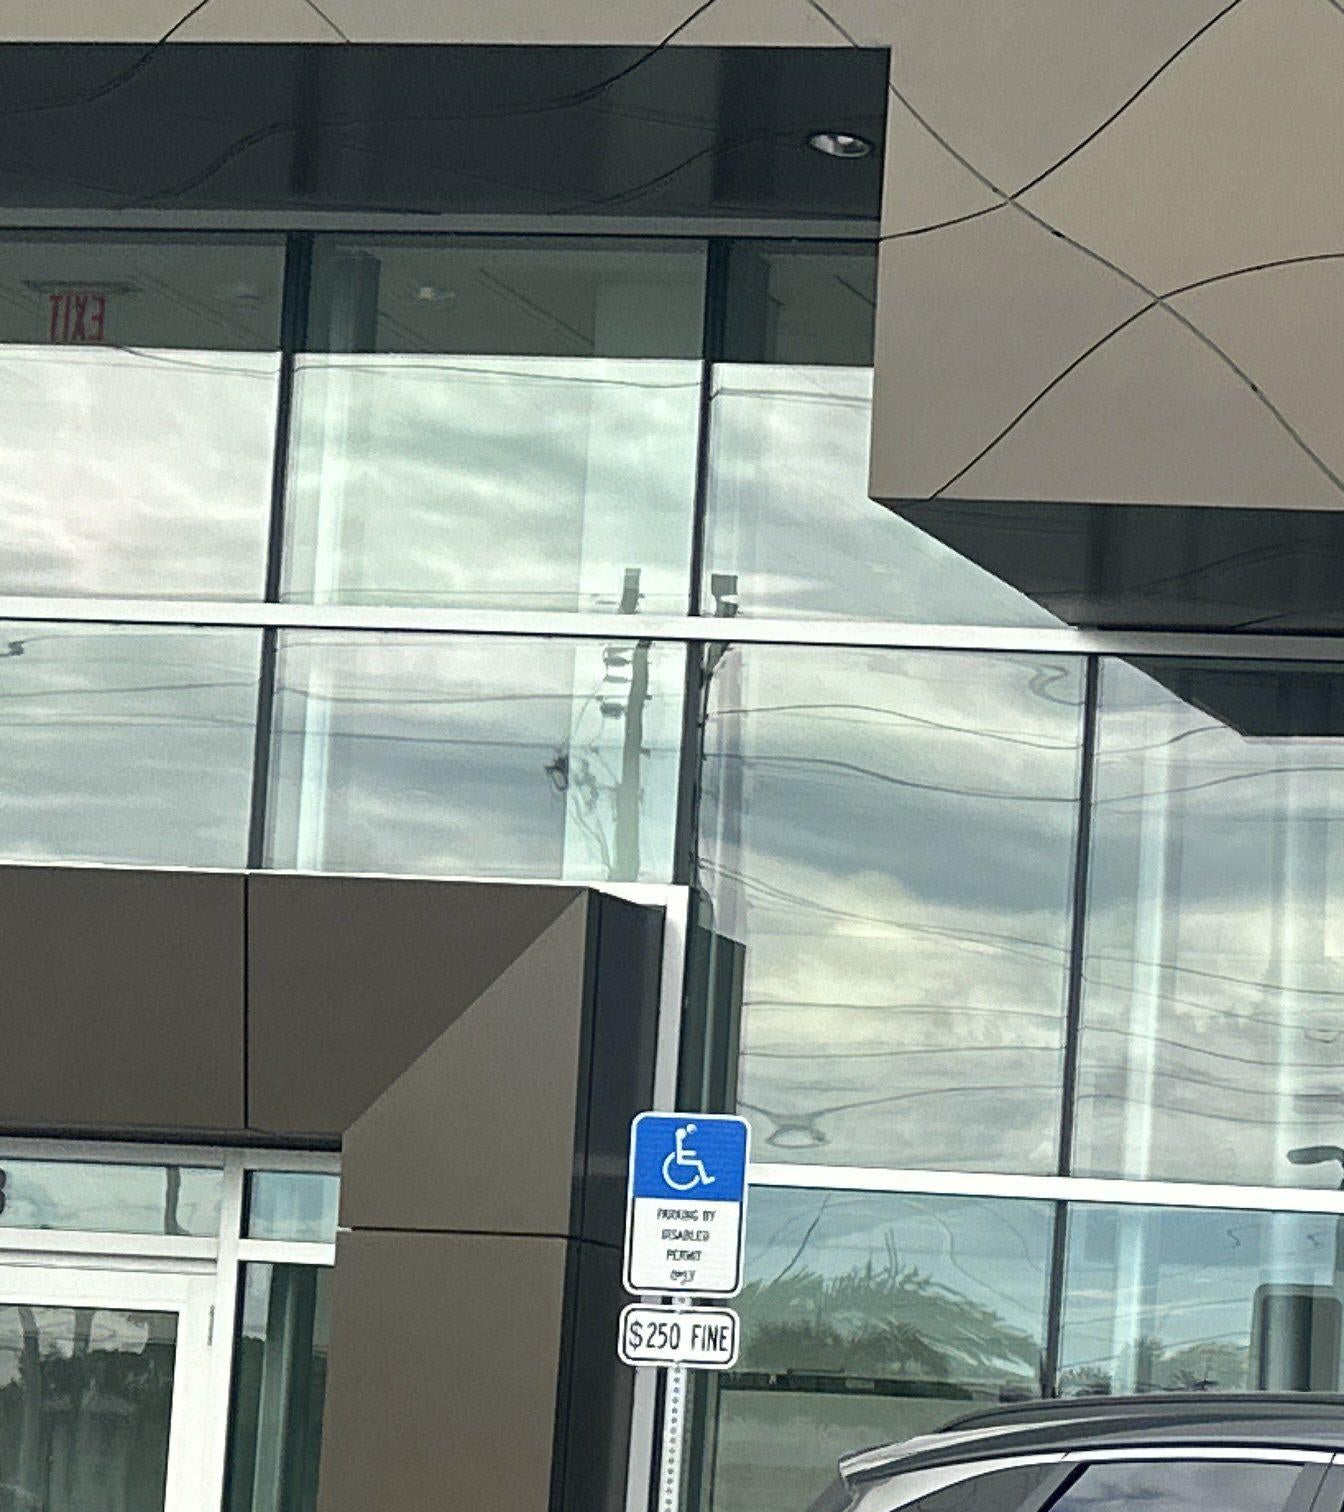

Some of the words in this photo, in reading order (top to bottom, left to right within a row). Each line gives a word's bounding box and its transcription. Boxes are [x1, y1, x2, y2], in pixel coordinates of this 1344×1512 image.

[656, 1208, 699, 1221] PARKING
[703, 1210, 716, 1222] BY
[661, 1229, 710, 1242] DISABLED
[666, 1249, 702, 1261] PERMIT
[628, 1320, 681, 1350] $250
[691, 1325, 730, 1352] FINE
